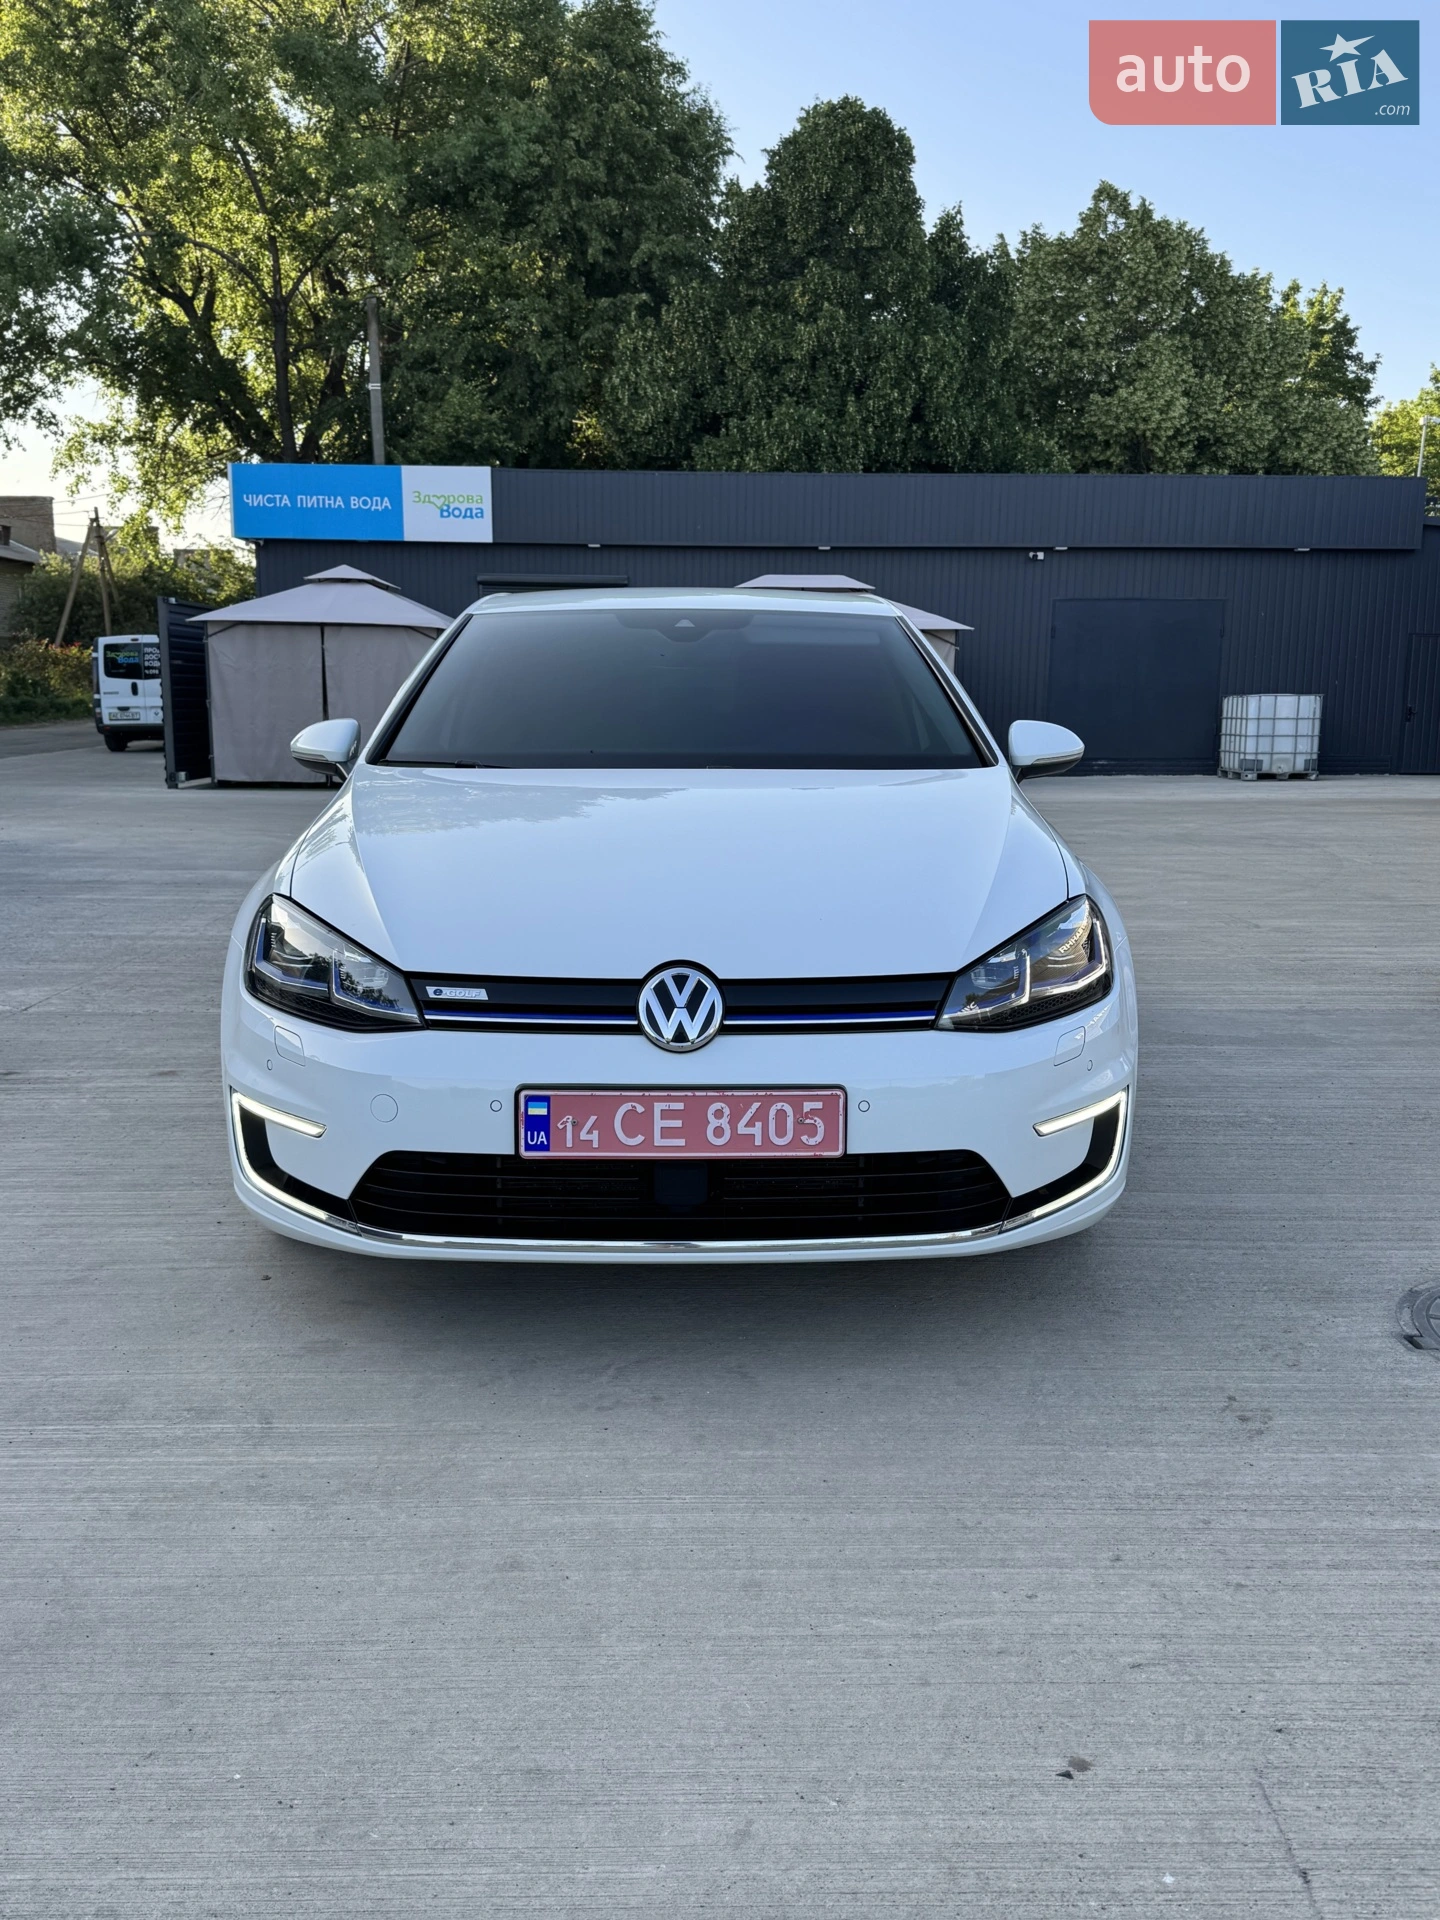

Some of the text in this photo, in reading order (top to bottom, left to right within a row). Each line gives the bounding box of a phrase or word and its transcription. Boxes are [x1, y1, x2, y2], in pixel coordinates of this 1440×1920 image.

[243, 494, 392, 512] ЧИСТА ПИТНА ВОДА
[440, 503, 485, 520] Вода
[557, 1101, 825, 1148] 14 CE 8405
[527, 1131, 547, 1145] UA
